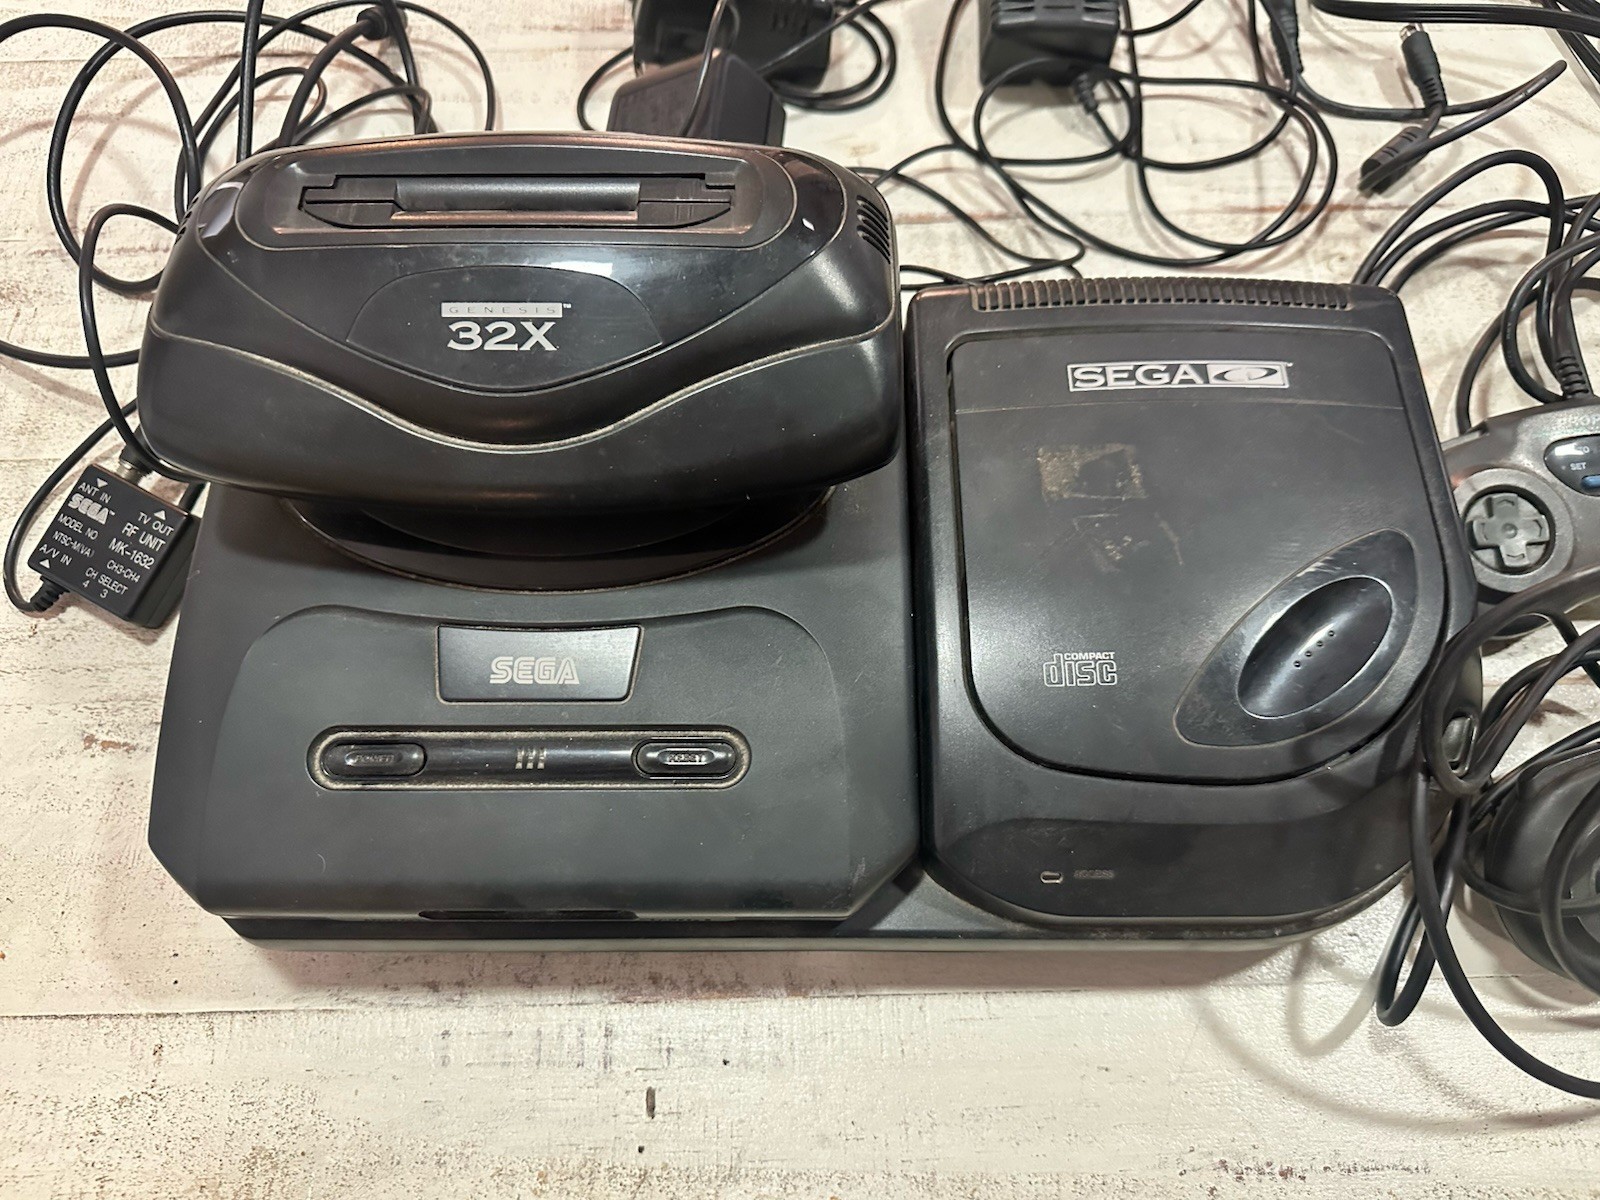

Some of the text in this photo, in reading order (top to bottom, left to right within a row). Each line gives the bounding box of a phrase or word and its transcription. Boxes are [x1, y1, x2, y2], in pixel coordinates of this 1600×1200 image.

[448, 305, 557, 315] GENESIS
[446, 319, 559, 351] 32X
[1072, 363, 1205, 388] SEGA
[77, 482, 113, 504] ANT IN
[67, 492, 110, 525] SEGA
[57, 513, 84, 534] MODEL
[138, 511, 175, 537] TV OUT
[121, 522, 167, 552] RF UNIT
[39, 543, 73, 566] A/V IN
[108, 537, 156, 570] MK-1632
[82, 579, 90, 589] 4
[85, 567, 129, 596] CH SELECT
[106, 559, 142, 584] CH3-CH4
[100, 588, 109, 599] 3
[1063, 651, 1116, 661] COMPACT
[489, 655, 581, 685] SEGA
[1042, 653, 1118, 687] disc
